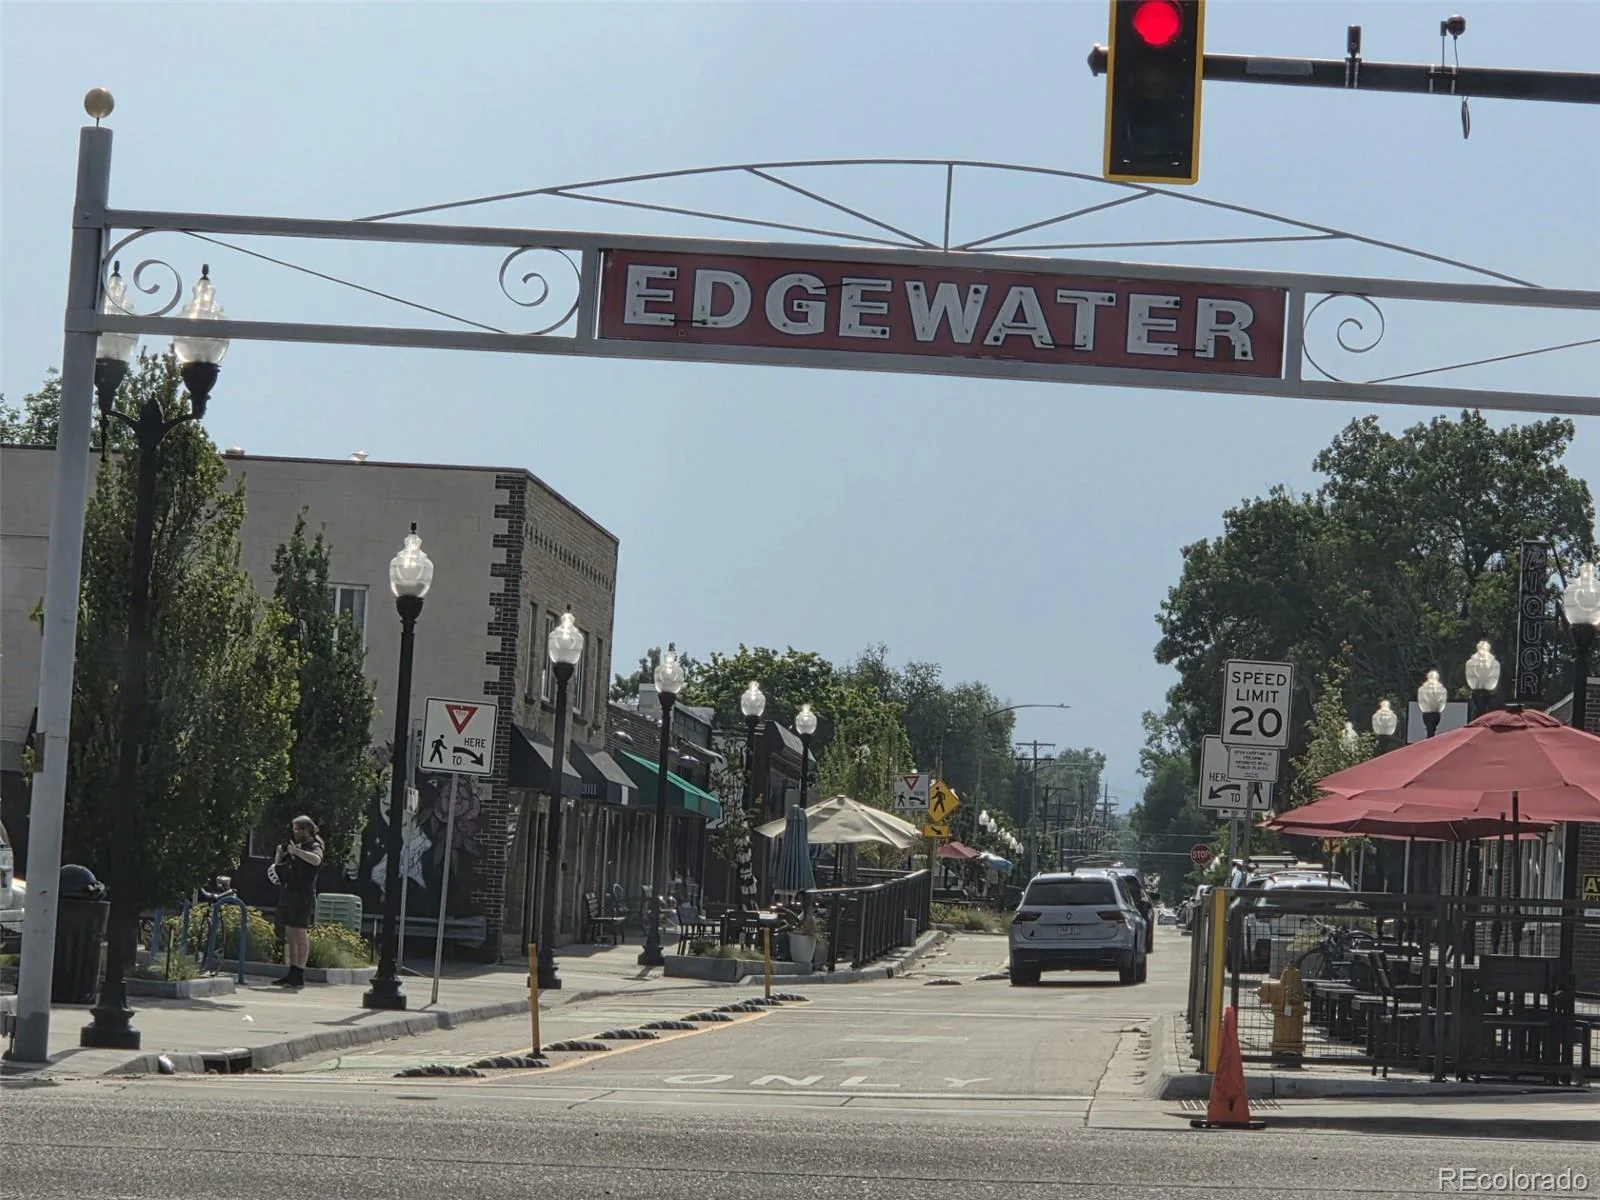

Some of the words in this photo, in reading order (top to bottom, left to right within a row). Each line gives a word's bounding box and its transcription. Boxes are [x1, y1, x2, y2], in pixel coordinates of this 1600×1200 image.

[623, 264, 1254, 361] EDGEWATER
[1520, 548, 1545, 694] LIQUOR
[1231, 671, 1287, 686] SPEED
[1236, 688, 1279, 703] LIMIT
[1229, 706, 1283, 738] 20
[464, 737, 486, 748] HERE
[452, 755, 463, 766] TO
[1230, 793, 1240, 803] TO
[663, 1074, 994, 1088] ONLY
